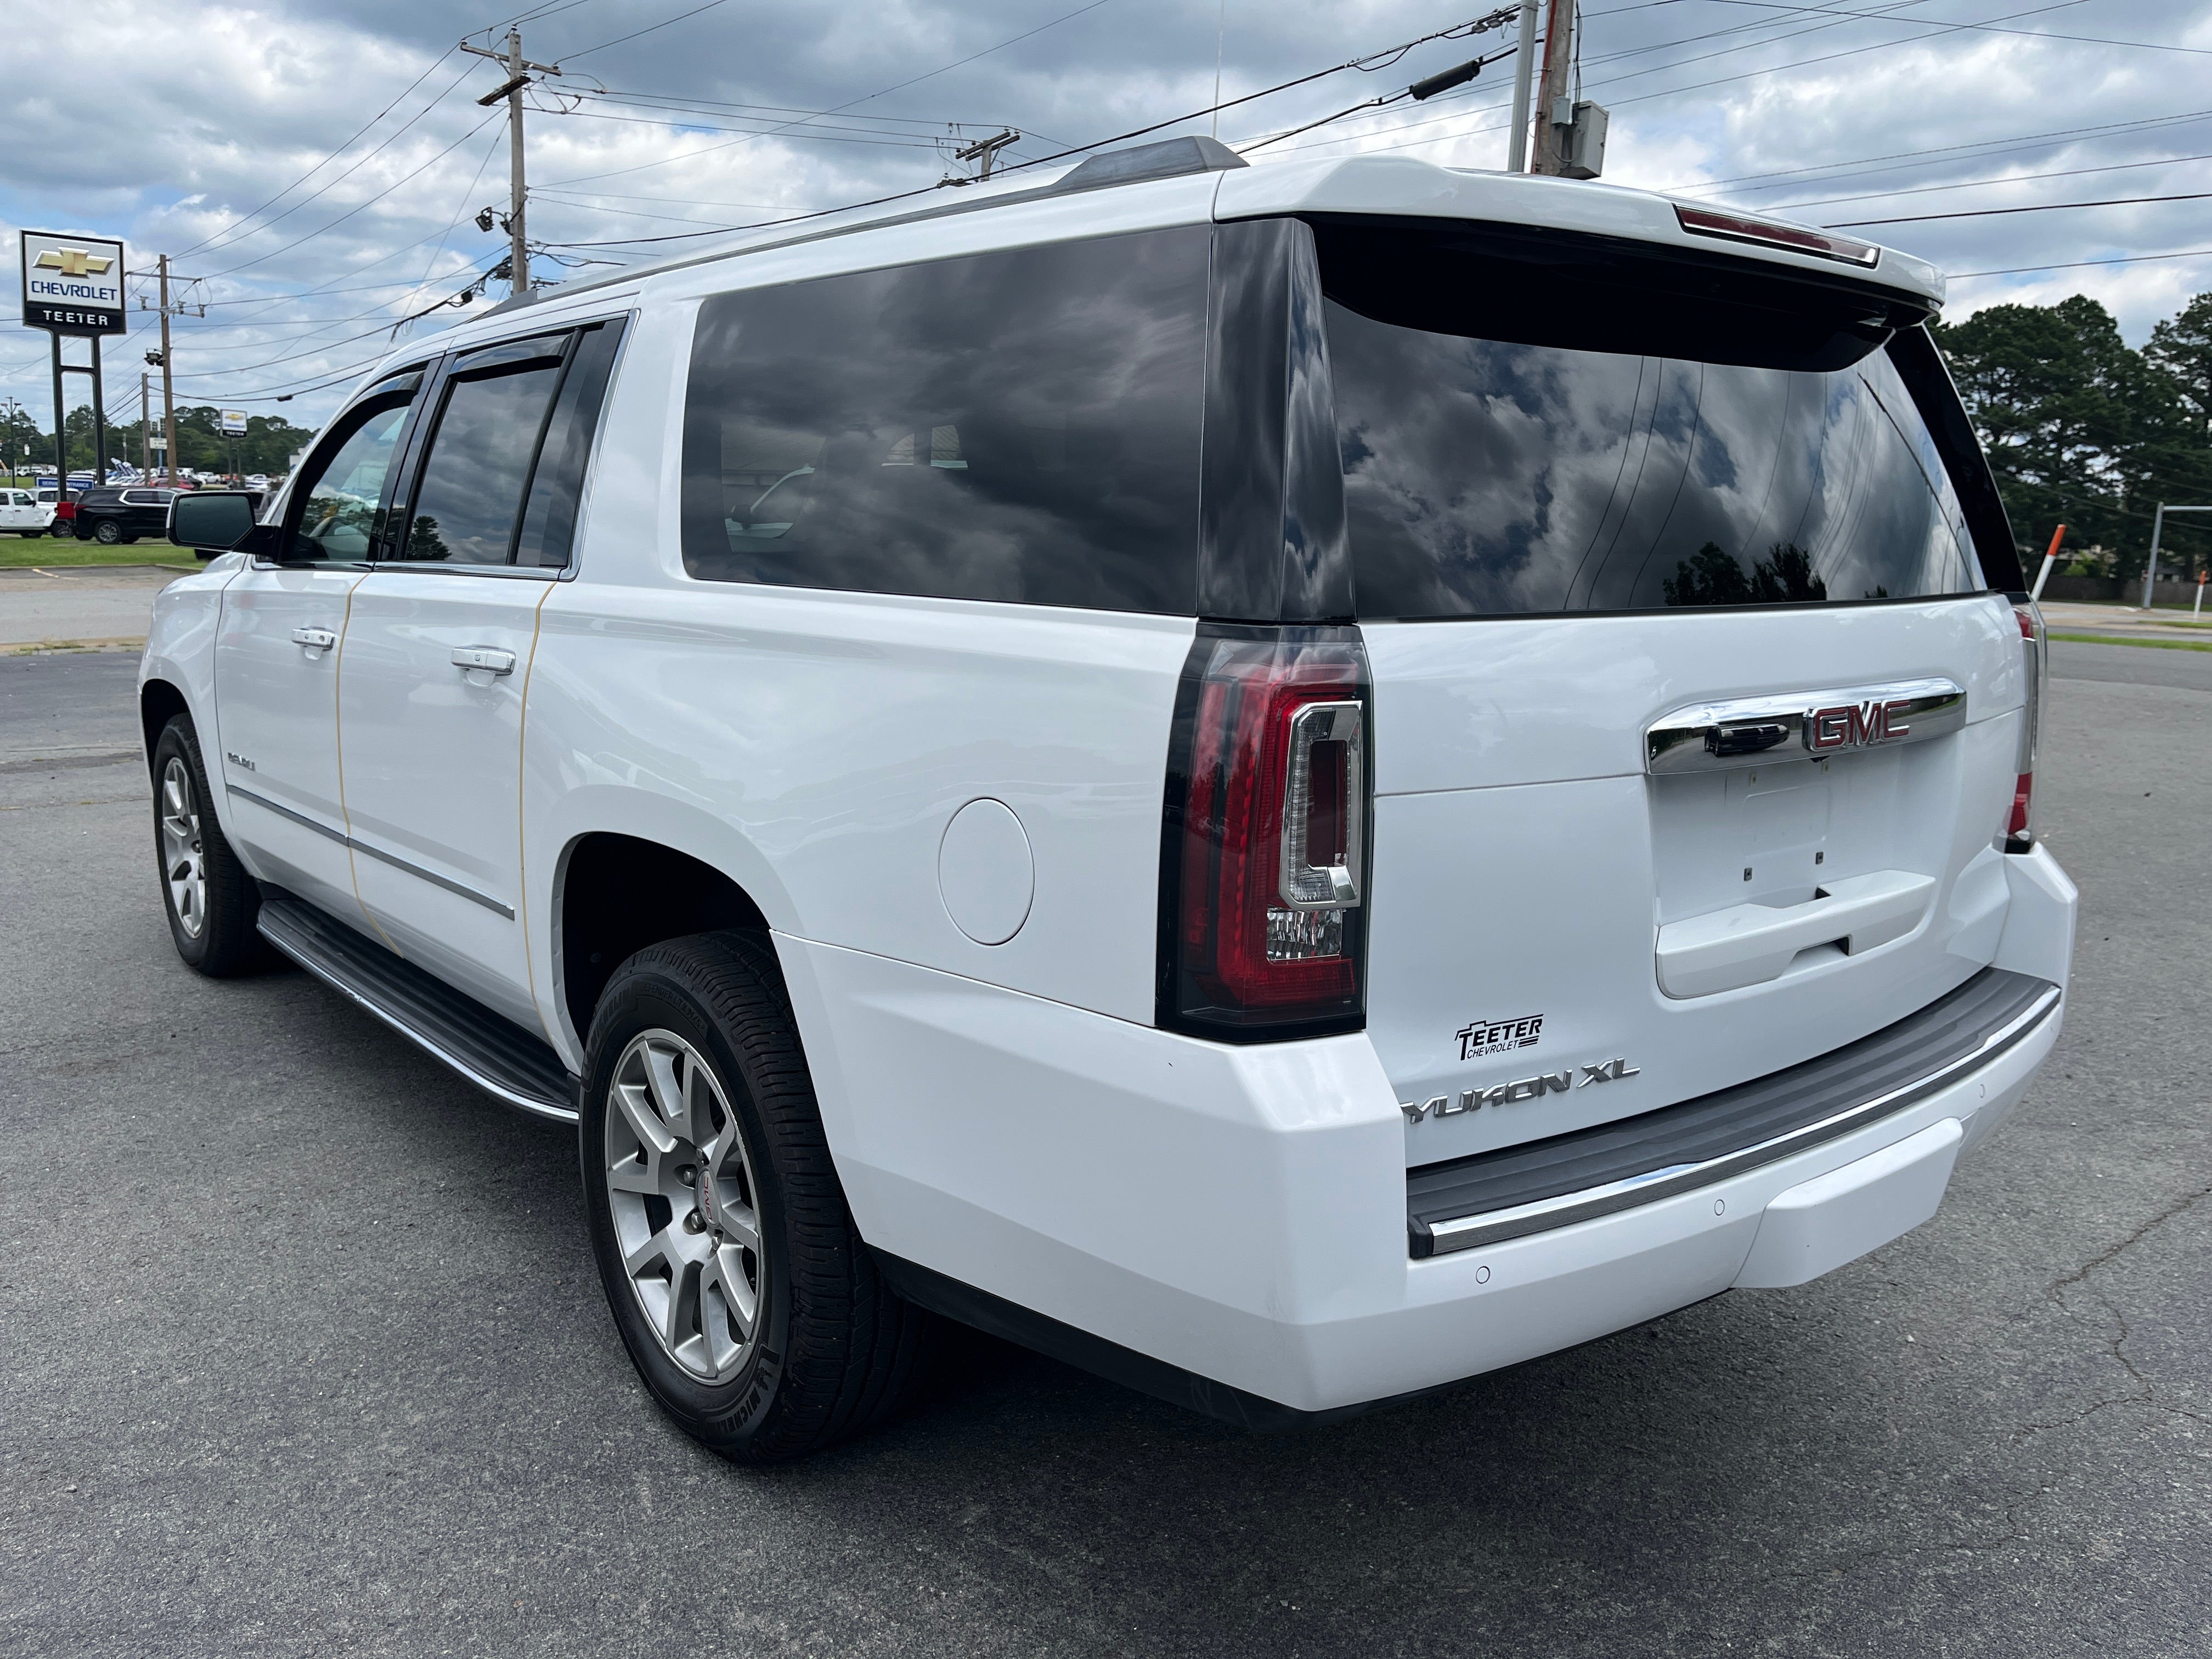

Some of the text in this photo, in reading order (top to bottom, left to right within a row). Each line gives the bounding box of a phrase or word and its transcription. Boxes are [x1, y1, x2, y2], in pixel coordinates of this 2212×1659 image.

[31, 280, 117, 301] CHEVROLET
[43, 310, 109, 326] TEETER
[1803, 700, 1911, 752] GMC
[1459, 1018, 1543, 1061] TEETER
[1467, 1039, 1519, 1059] CHEVROLET
[1400, 1057, 1641, 1124] YUKON XL
[704, 1176, 713, 1220] GMC
